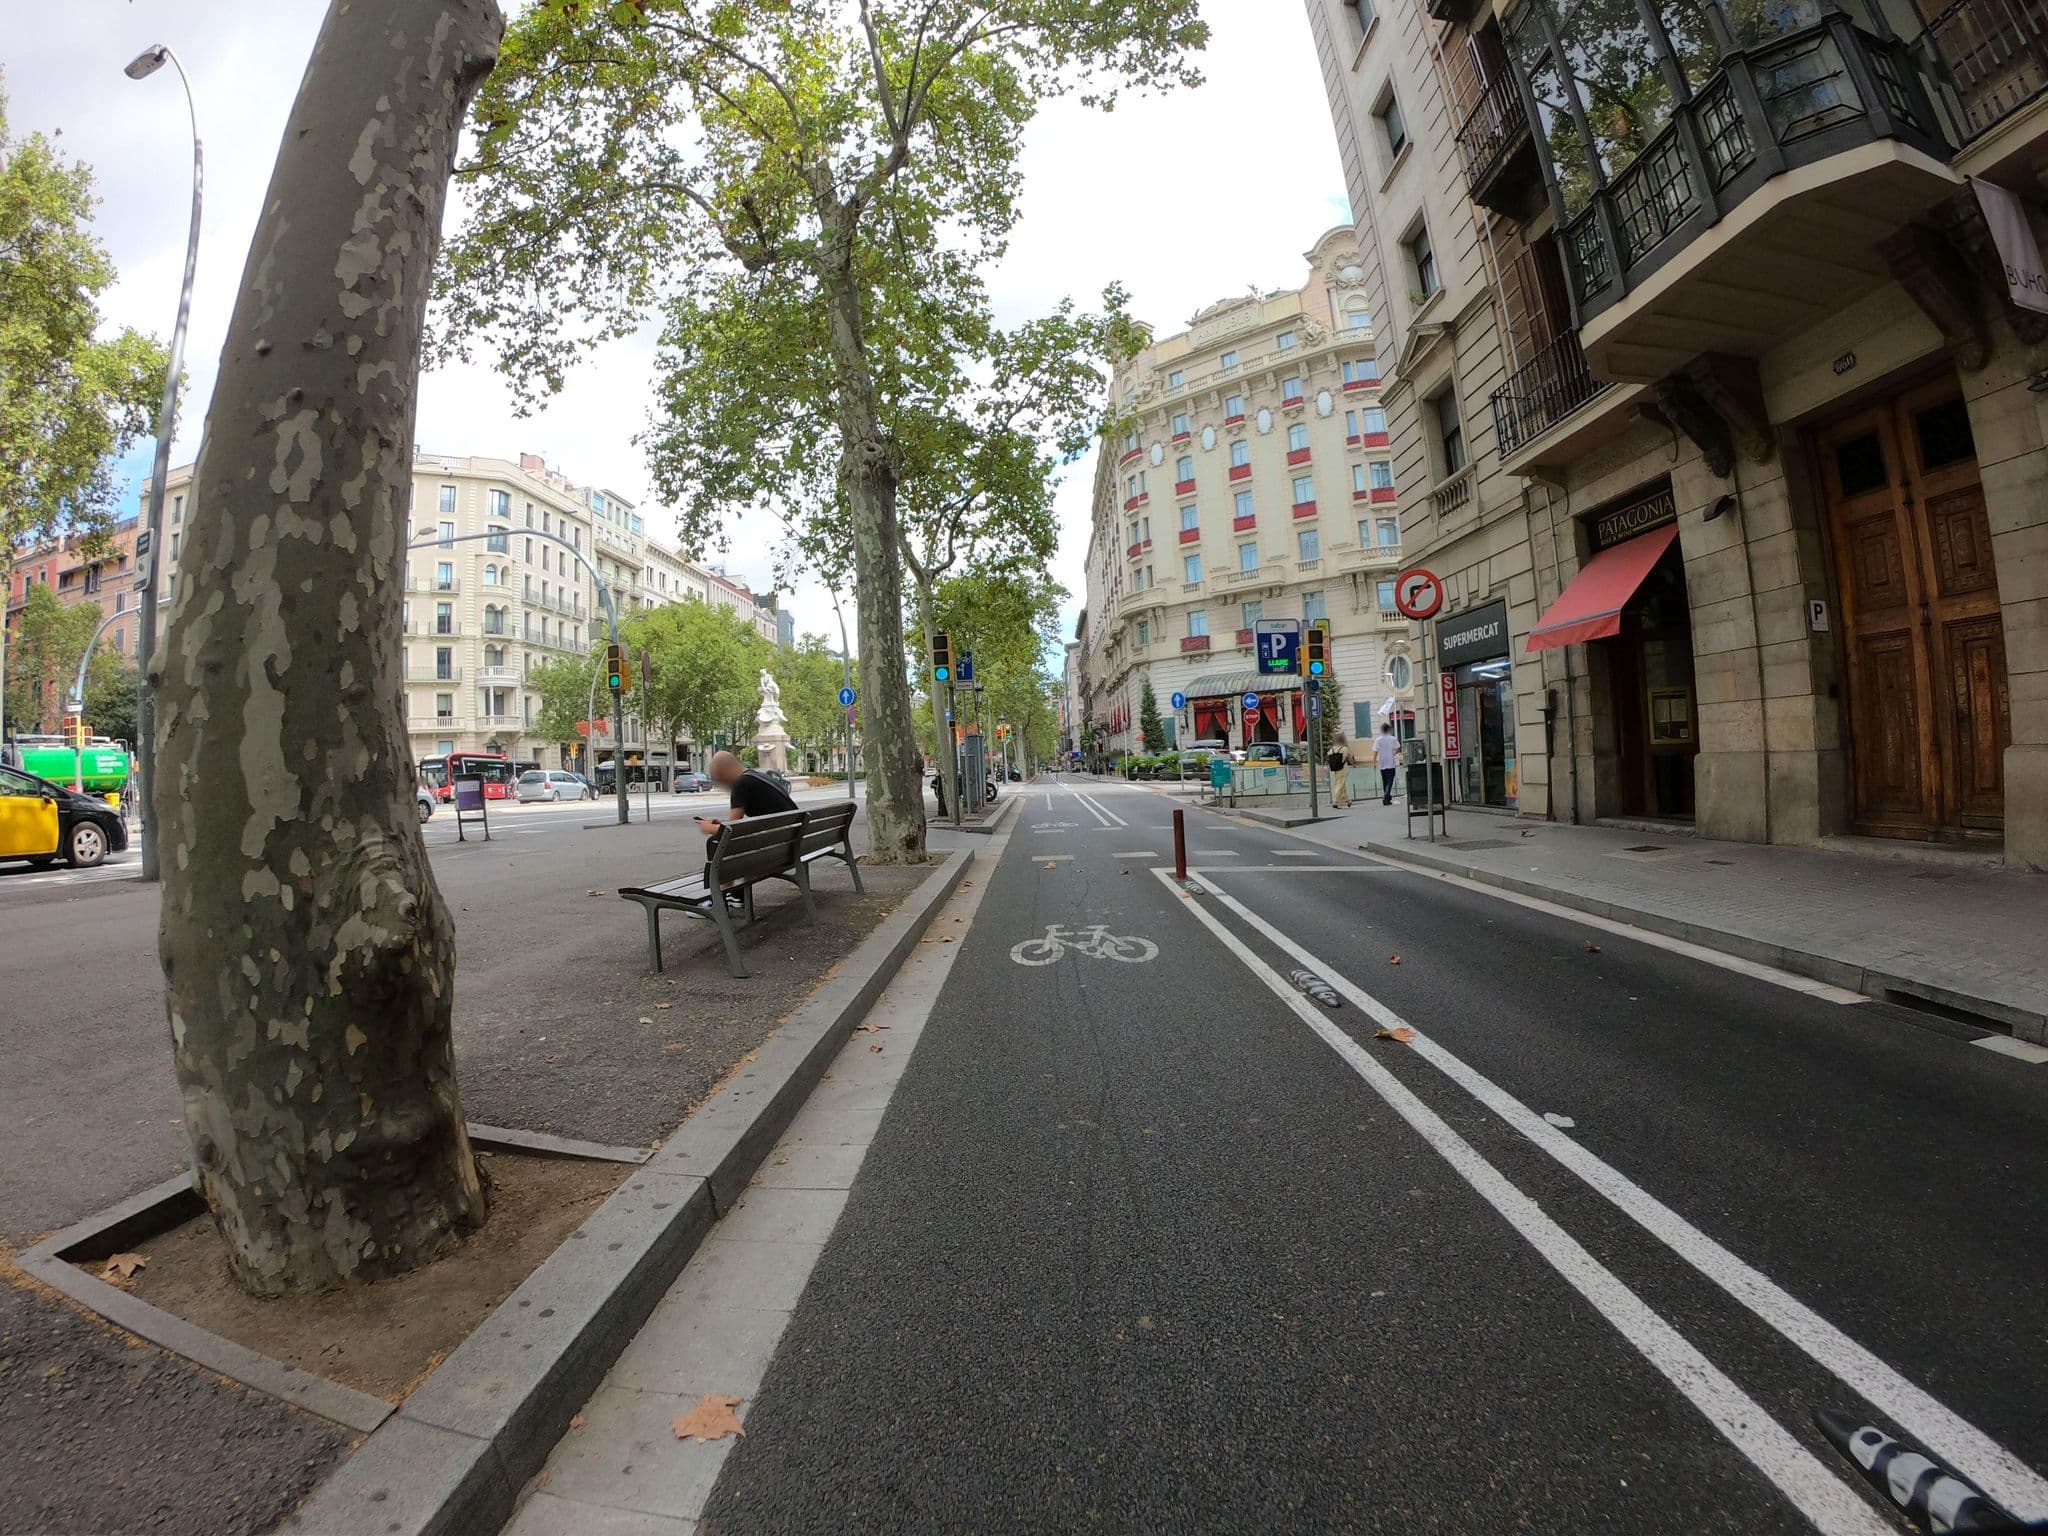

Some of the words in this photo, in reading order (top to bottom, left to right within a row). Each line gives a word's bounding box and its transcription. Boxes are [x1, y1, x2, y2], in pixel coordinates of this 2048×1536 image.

[1598, 495, 1674, 540] PATAGONIA
[1814, 603, 1823, 621] P
[1270, 633, 1287, 658] P
[1443, 621, 1499, 650] SUPERMERCAT
[1444, 676, 1457, 748] SUPER
